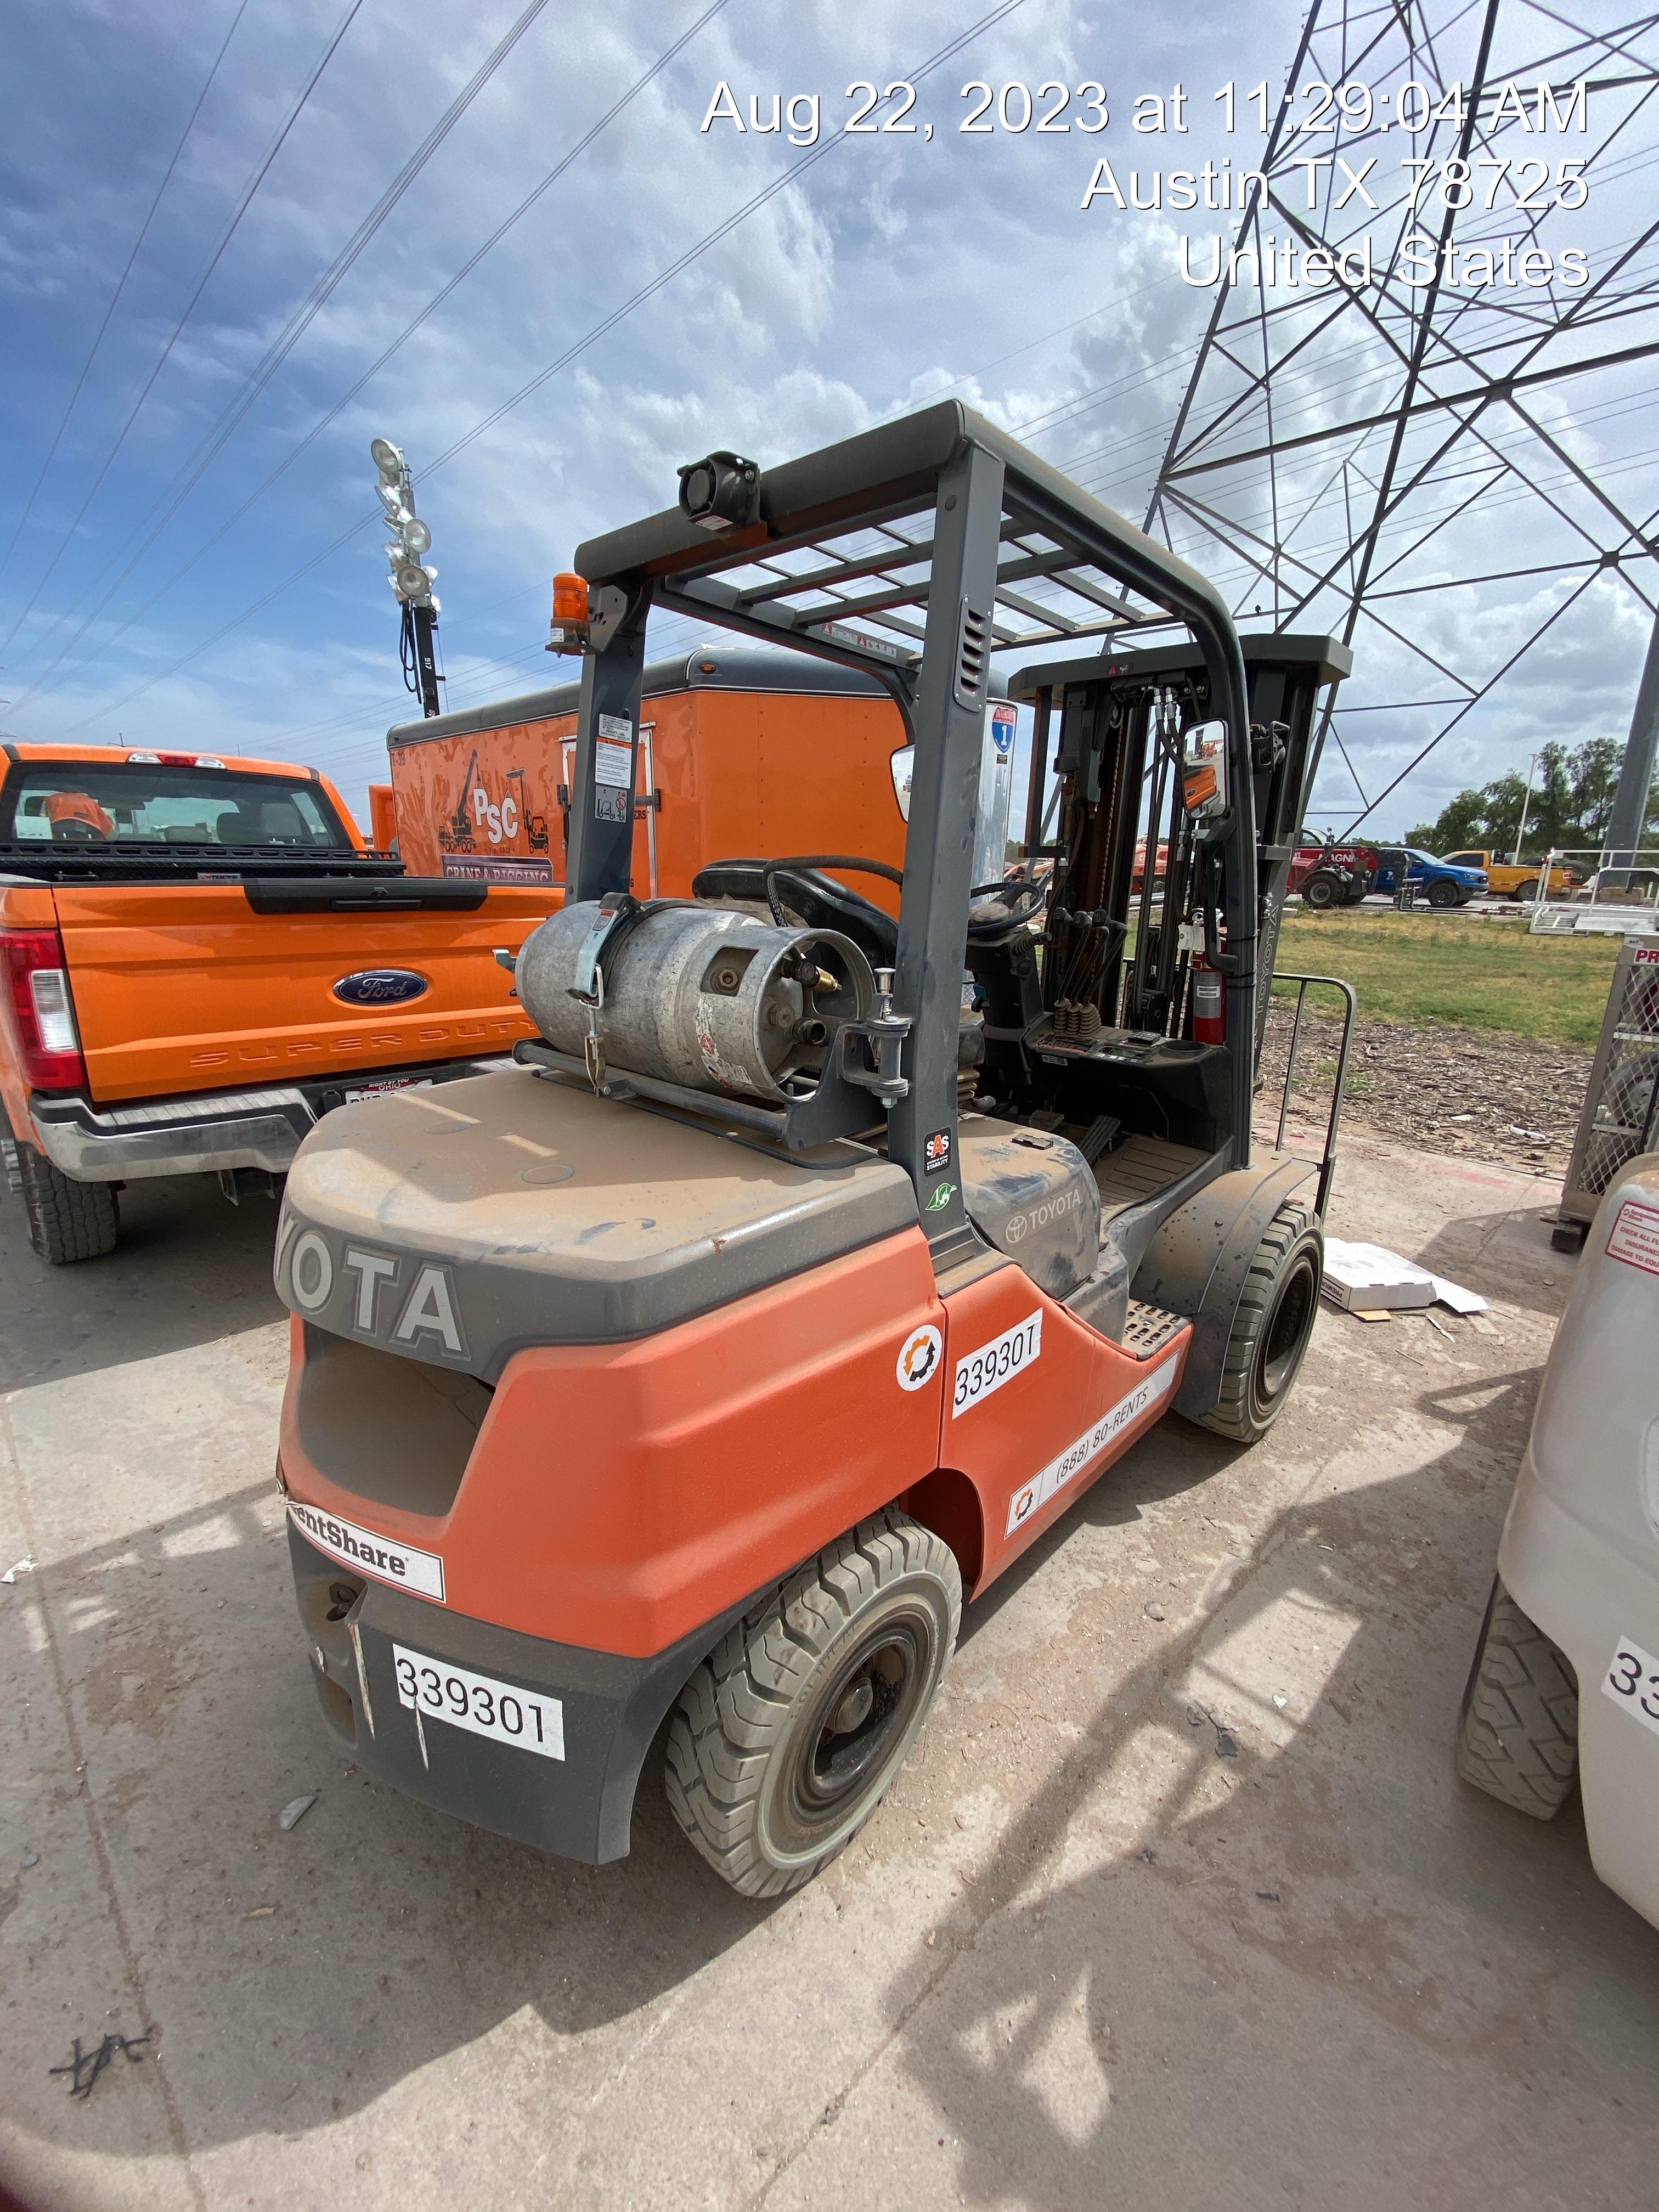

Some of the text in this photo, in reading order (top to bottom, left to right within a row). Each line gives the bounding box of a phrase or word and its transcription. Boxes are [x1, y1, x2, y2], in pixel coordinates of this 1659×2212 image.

[1001, 725, 1007, 746] 1
[473, 788, 519, 844] PSC
[358, 978, 408, 999] Ford
[190, 1034, 403, 1068] SUPER
[379, 1082, 401, 1091] OHIO
[927, 1135, 949, 1158] SAS
[927, 1158, 948, 1171] STABILITY
[1029, 1188, 1081, 1229] TOYOTA
[1620, 1226, 1638, 1238] CHECK
[1638, 1234, 1650, 1242] ALL
[1611, 1244, 1634, 1259] DAMAGE
[955, 1323, 1035, 1406] 339301
[1056, 1386, 1148, 1484] (888) 80-RENTS
[397, 1658, 543, 1743] 339301
